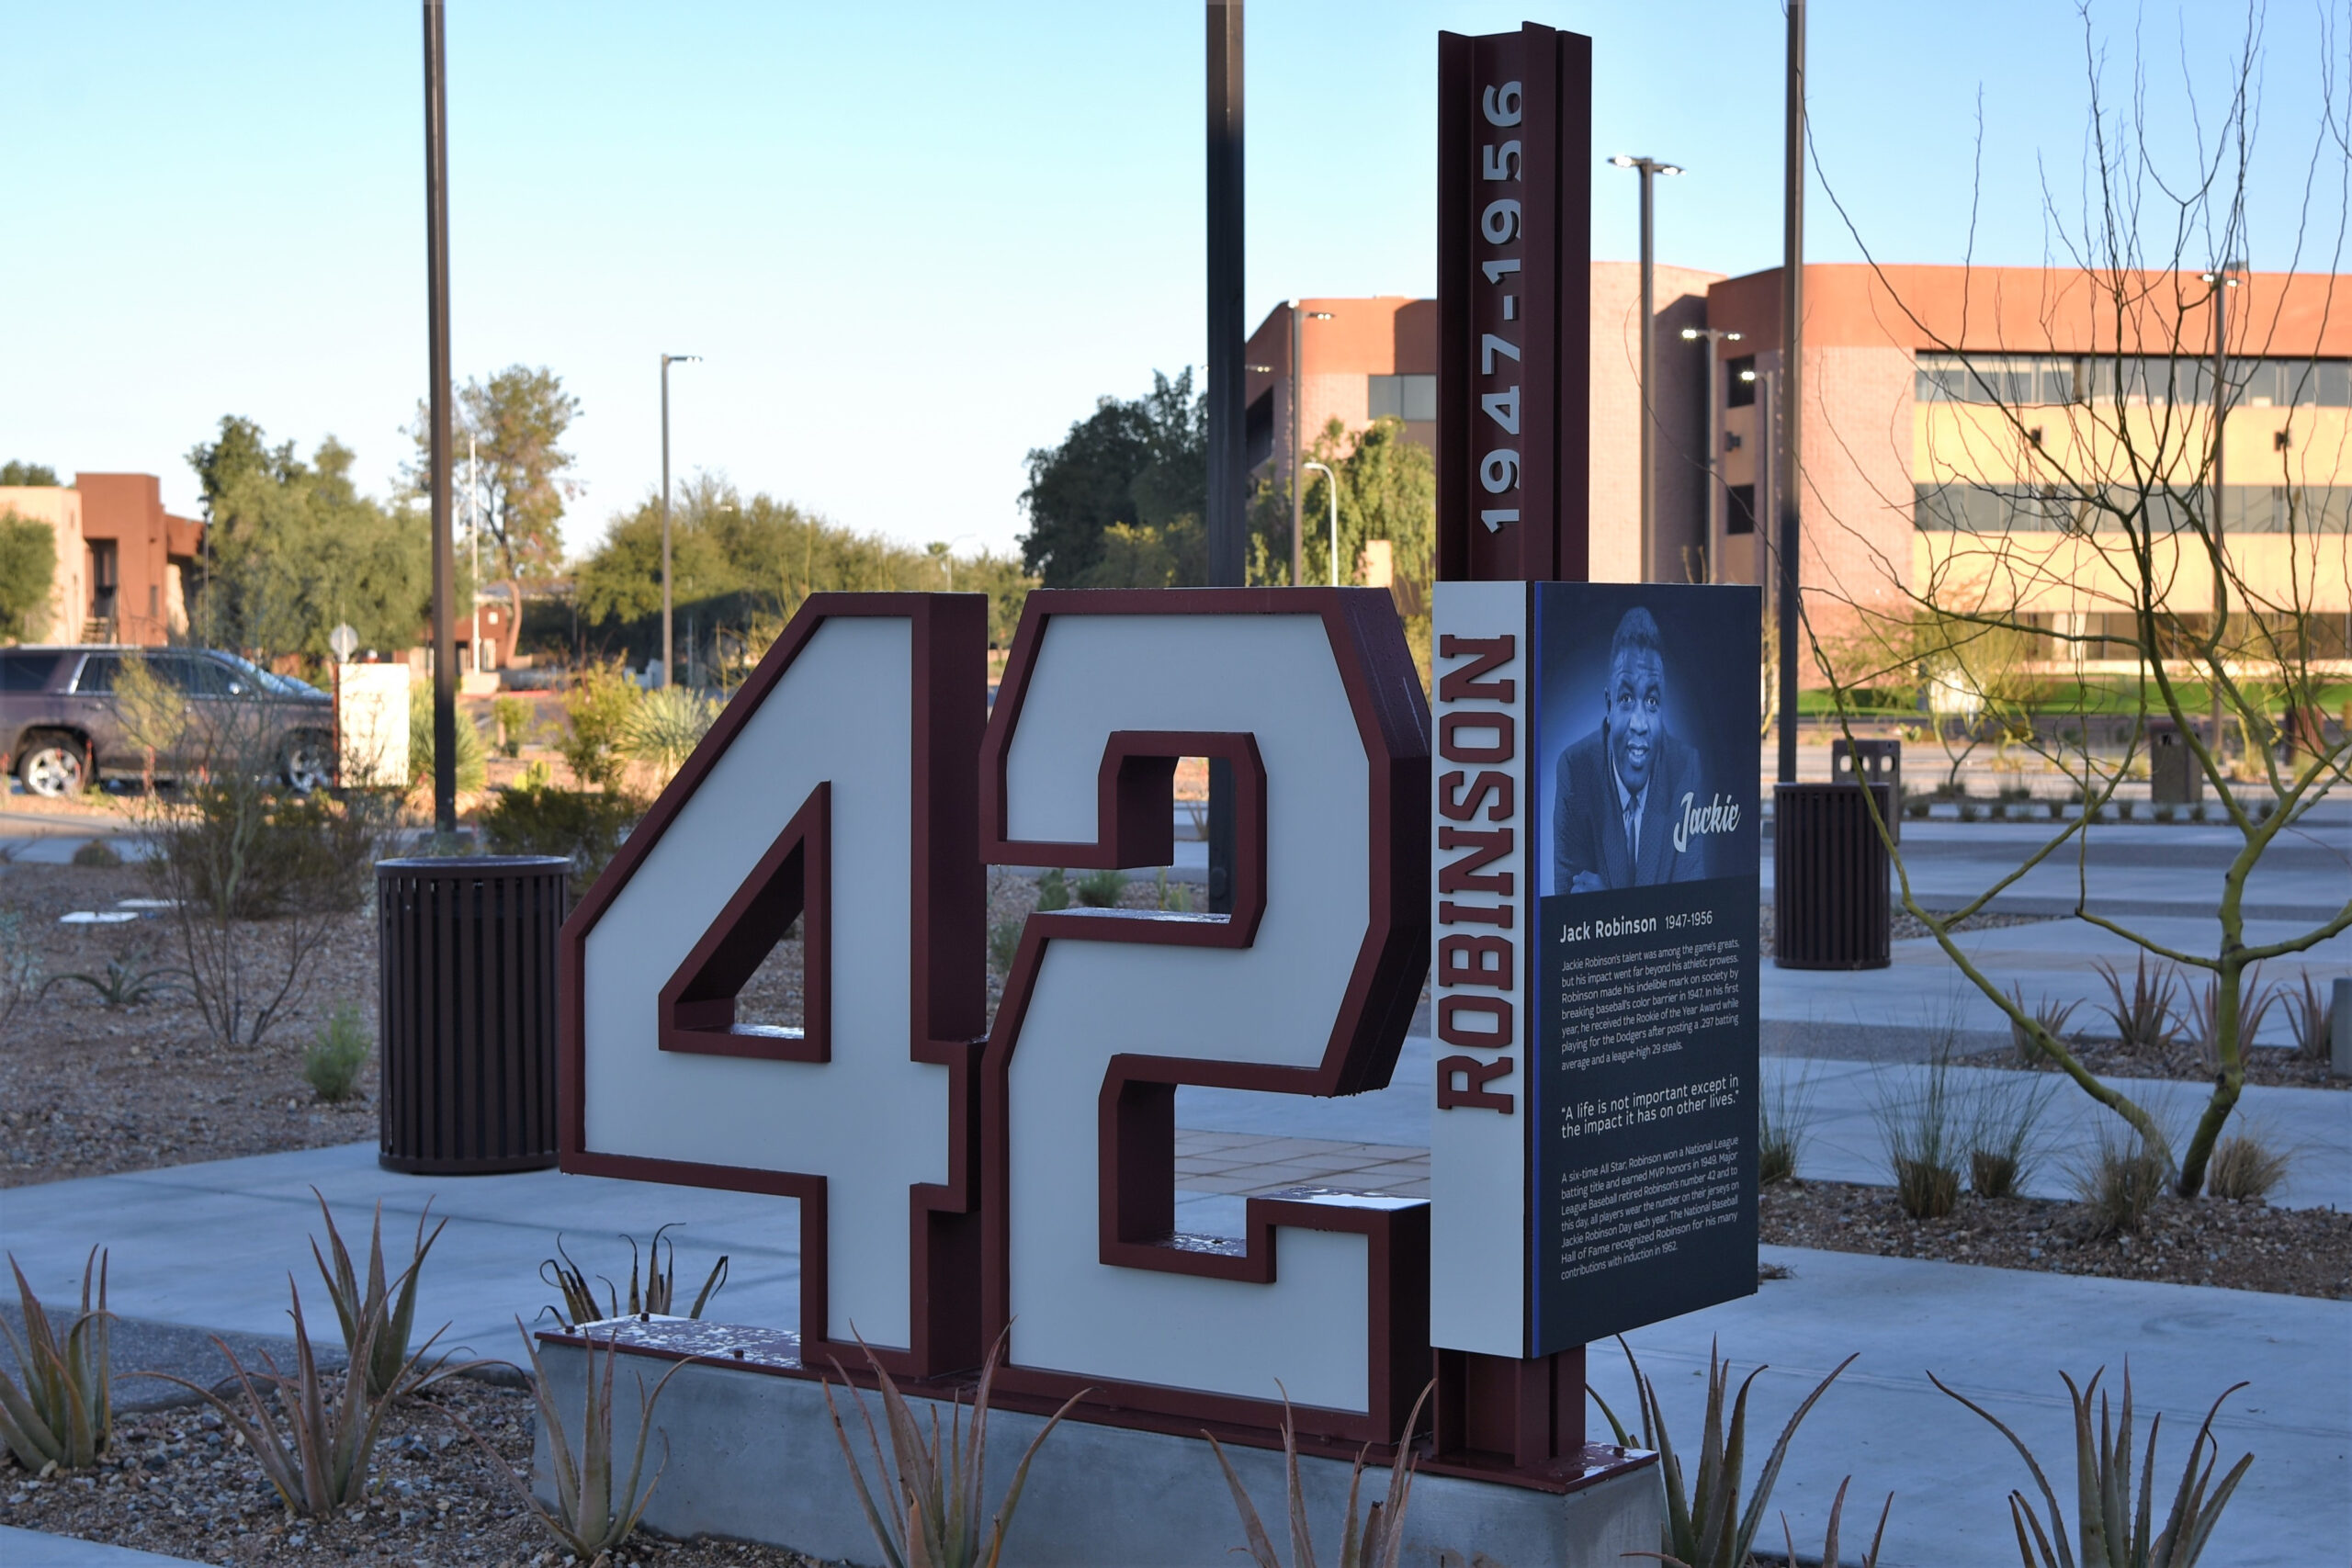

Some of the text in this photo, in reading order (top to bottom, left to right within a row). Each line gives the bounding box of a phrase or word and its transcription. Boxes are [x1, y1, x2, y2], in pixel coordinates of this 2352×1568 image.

[1480, 80, 1522, 534] 1947-1956
[1673, 792, 1741, 852] Jackie
[1437, 634, 1515, 1114] ROBINSON
[1560, 910, 1713, 942] Jack Robinson 1947-1956
[1562, 976, 1574, 987] but
[1577, 974, 1586, 986] his
[1588, 972, 1611, 985] impact
[1614, 969, 1631, 979] went
[1634, 966, 1643, 976] far
[1645, 962, 1670, 976] beyond
[1672, 961, 1681, 971] his
[1683, 957, 1708, 969] athletic
[1563, 957, 1583, 971] Jackie
[1623, 951, 1642, 963] talent
[1644, 950, 1657, 959] was
[1658, 947, 1680, 959] among
[1682, 944, 1692, 953] the
[1562, 968, 1738, 1003] Robinson made his indelible mark on society by
[1562, 1006, 1594, 1020] breaking
[1633, 998, 1651, 1009] color
[1653, 993, 1678, 1005] barrier
[1679, 991, 1686, 1001] in
[1706, 987, 1712, 997] In
[1713, 985, 1723, 995] his
[1725, 984, 1738, 992] first
[560, 587, 1430, 1446] 42
[1562, 1039, 1588, 1055] playing
[1589, 1036, 1600, 1047] for
[1602, 1034, 1614, 1044] the
[1617, 1030, 1646, 1043] Dodgers
[1648, 1025, 1666, 1037] after
[1668, 1021, 1692, 1036] posting
[1694, 1021, 1698, 1029] a
[1715, 1013, 1738, 1026] batting
[1581, 1022, 1589, 1032] he
[1591, 1017, 1622, 1030] received
[1623, 1014, 1634, 1025] the
[1636, 1011, 1658, 1023] Rookie
[1661, 1009, 1668, 1020] of
[1670, 1007, 1680, 1017] the
[1682, 1006, 1698, 1016] Year
[1700, 1000, 1721, 1013] Award
[1723, 998, 1738, 1009] while
[1562, 1058, 1589, 1070] average
[1591, 1054, 1604, 1067] and
[1606, 1054, 1610, 1063] a
[1612, 1045, 1650, 1063] league-high
[1653, 1043, 1660, 1054] 29
[1562, 1122, 1580, 1138] the
[1585, 1113, 1623, 1135] impact
[1626, 1111, 1634, 1125] it
[1637, 1108, 1657, 1123] has
[1660, 1106, 1673, 1118] on
[1677, 1098, 1706, 1115] other
[1577, 1101, 1594, 1118] life
[1598, 1100, 1606, 1113] is
[1611, 1096, 1629, 1111] not
[1633, 1085, 1688, 1108] important
[1691, 1077, 1725, 1097] except
[1730, 1074, 1738, 1089] in
[1562, 1173, 1566, 1183] A
[1569, 1168, 1598, 1181] six-time
[1600, 1163, 1609, 1175] All
[1629, 1155, 1661, 1168] Robinson
[1663, 1150, 1678, 1160] won
[1686, 1140, 1713, 1155] National
[1714, 1136, 1738, 1149] League
[1562, 1185, 1588, 1200] batting
[1590, 1180, 1604, 1193] title
[1606, 1177, 1620, 1190] and
[1622, 1171, 1647, 1185] earned
[1649, 1167, 1665, 1179] MVP
[1667, 1162, 1691, 1175] honors
[1693, 1158, 1699, 1168] in
[1719, 1151, 1738, 1164] Major
[1562, 1202, 1587, 1216] League
[1589, 1192, 1617, 1209] Baseball
[1619, 1187, 1643, 1201] retired
[1680, 1174, 1705, 1187] number
[1707, 1170, 1715, 1179] 42
[1717, 1167, 1729, 1179] and
[1731, 1167, 1737, 1175] to
[1562, 1219, 1574, 1231] this
[1600, 1208, 1623, 1224] players
[1625, 1204, 1642, 1216] wear
[1644, 1201, 1654, 1211] the
[1656, 1195, 1680, 1209] number
[1682, 1193, 1690, 1202] on
[1691, 1187, 1706, 1200] their
[1707, 1184, 1729, 1199] jerseys
[1731, 1181, 1739, 1190] on
[1562, 1234, 1583, 1247] Jackie
[1586, 1227, 1617, 1242] Robinson
[1619, 1223, 1632, 1235] Day
[1634, 1216, 1650, 1229] each
[1670, 1210, 1682, 1220] The
[1684, 1201, 1711, 1217] National
[1713, 1194, 1738, 1210] Baseball
[1562, 1212, 1737, 1264] Hall of Fame recognized Robinson for his many
[1561, 1261, 1606, 1280] contributions
[1608, 1256, 1622, 1268] with
[1623, 1247, 1654, 1263] induction
[1655, 1245, 1660, 1256] in
